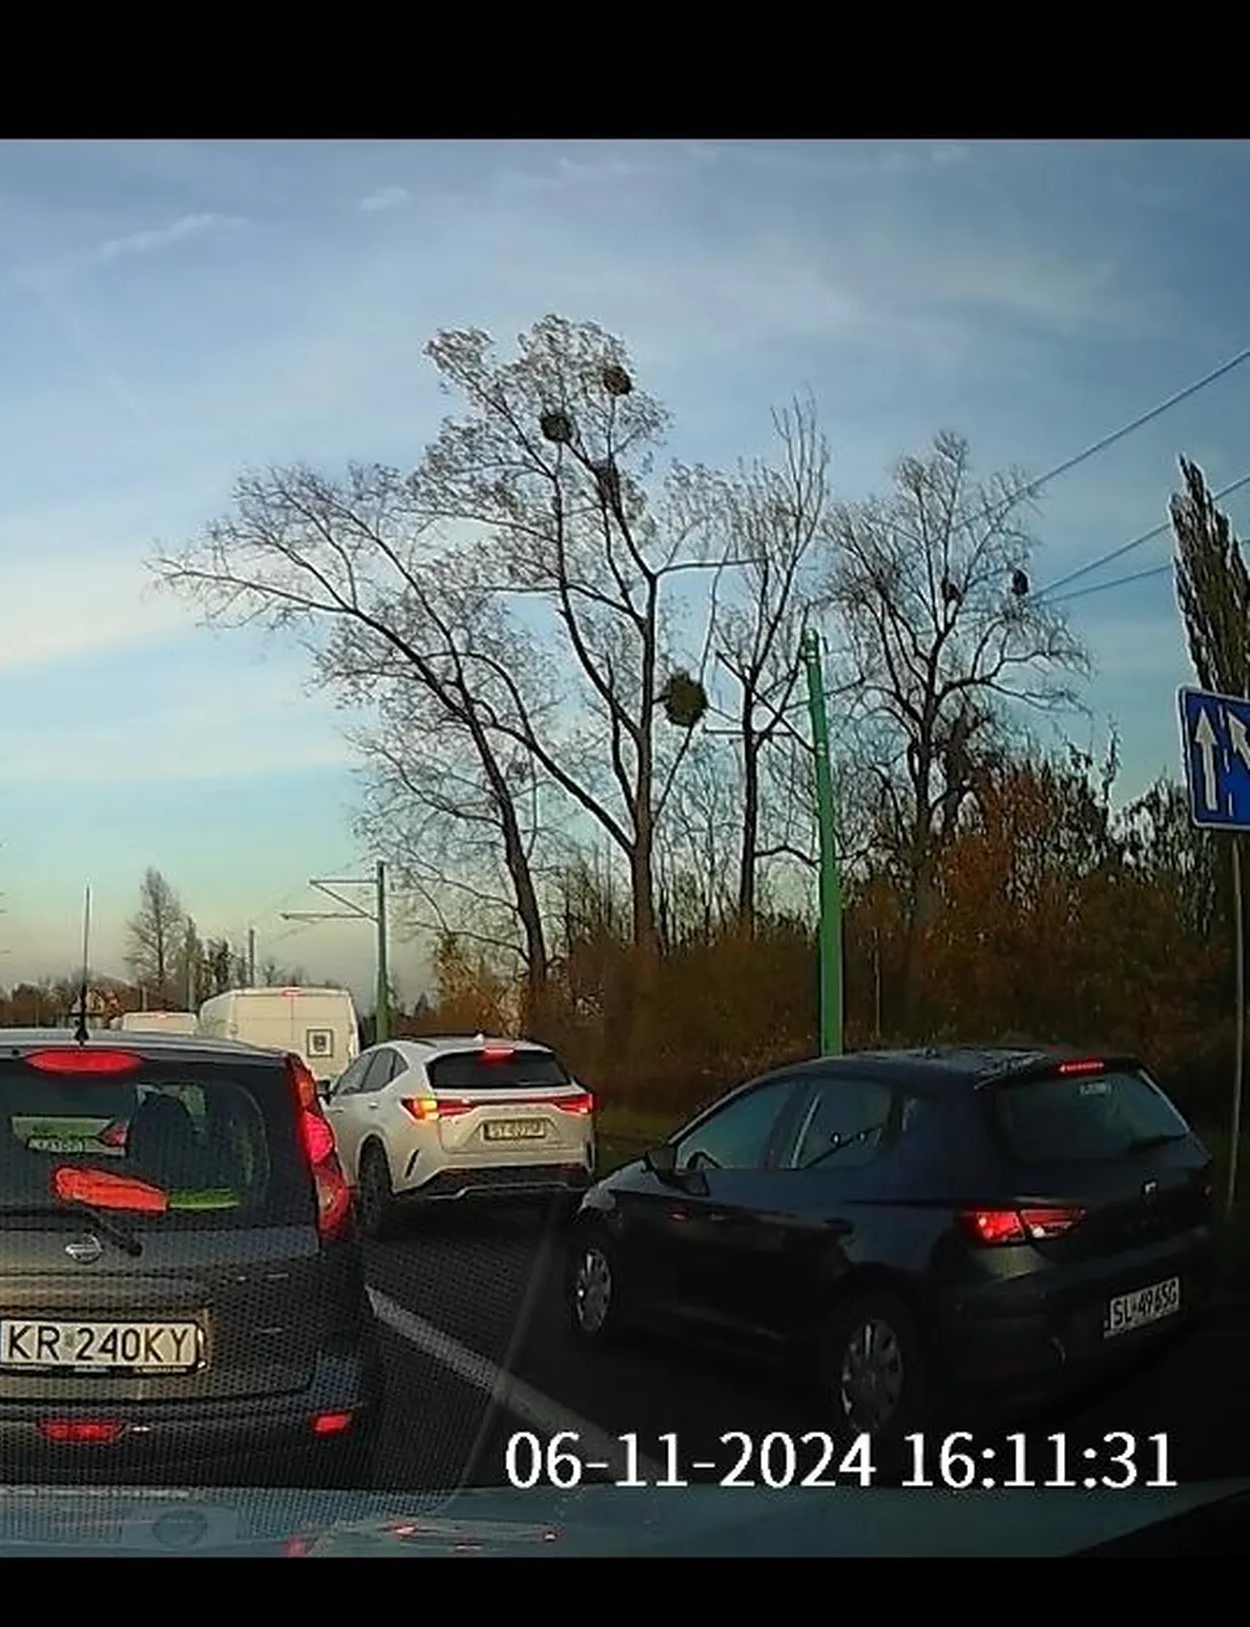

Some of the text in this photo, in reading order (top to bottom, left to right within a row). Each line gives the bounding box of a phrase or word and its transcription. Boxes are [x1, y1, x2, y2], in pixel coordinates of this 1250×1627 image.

[1113, 1297, 1133, 1326] SL
[7, 1324, 190, 1363] KR 240KY
